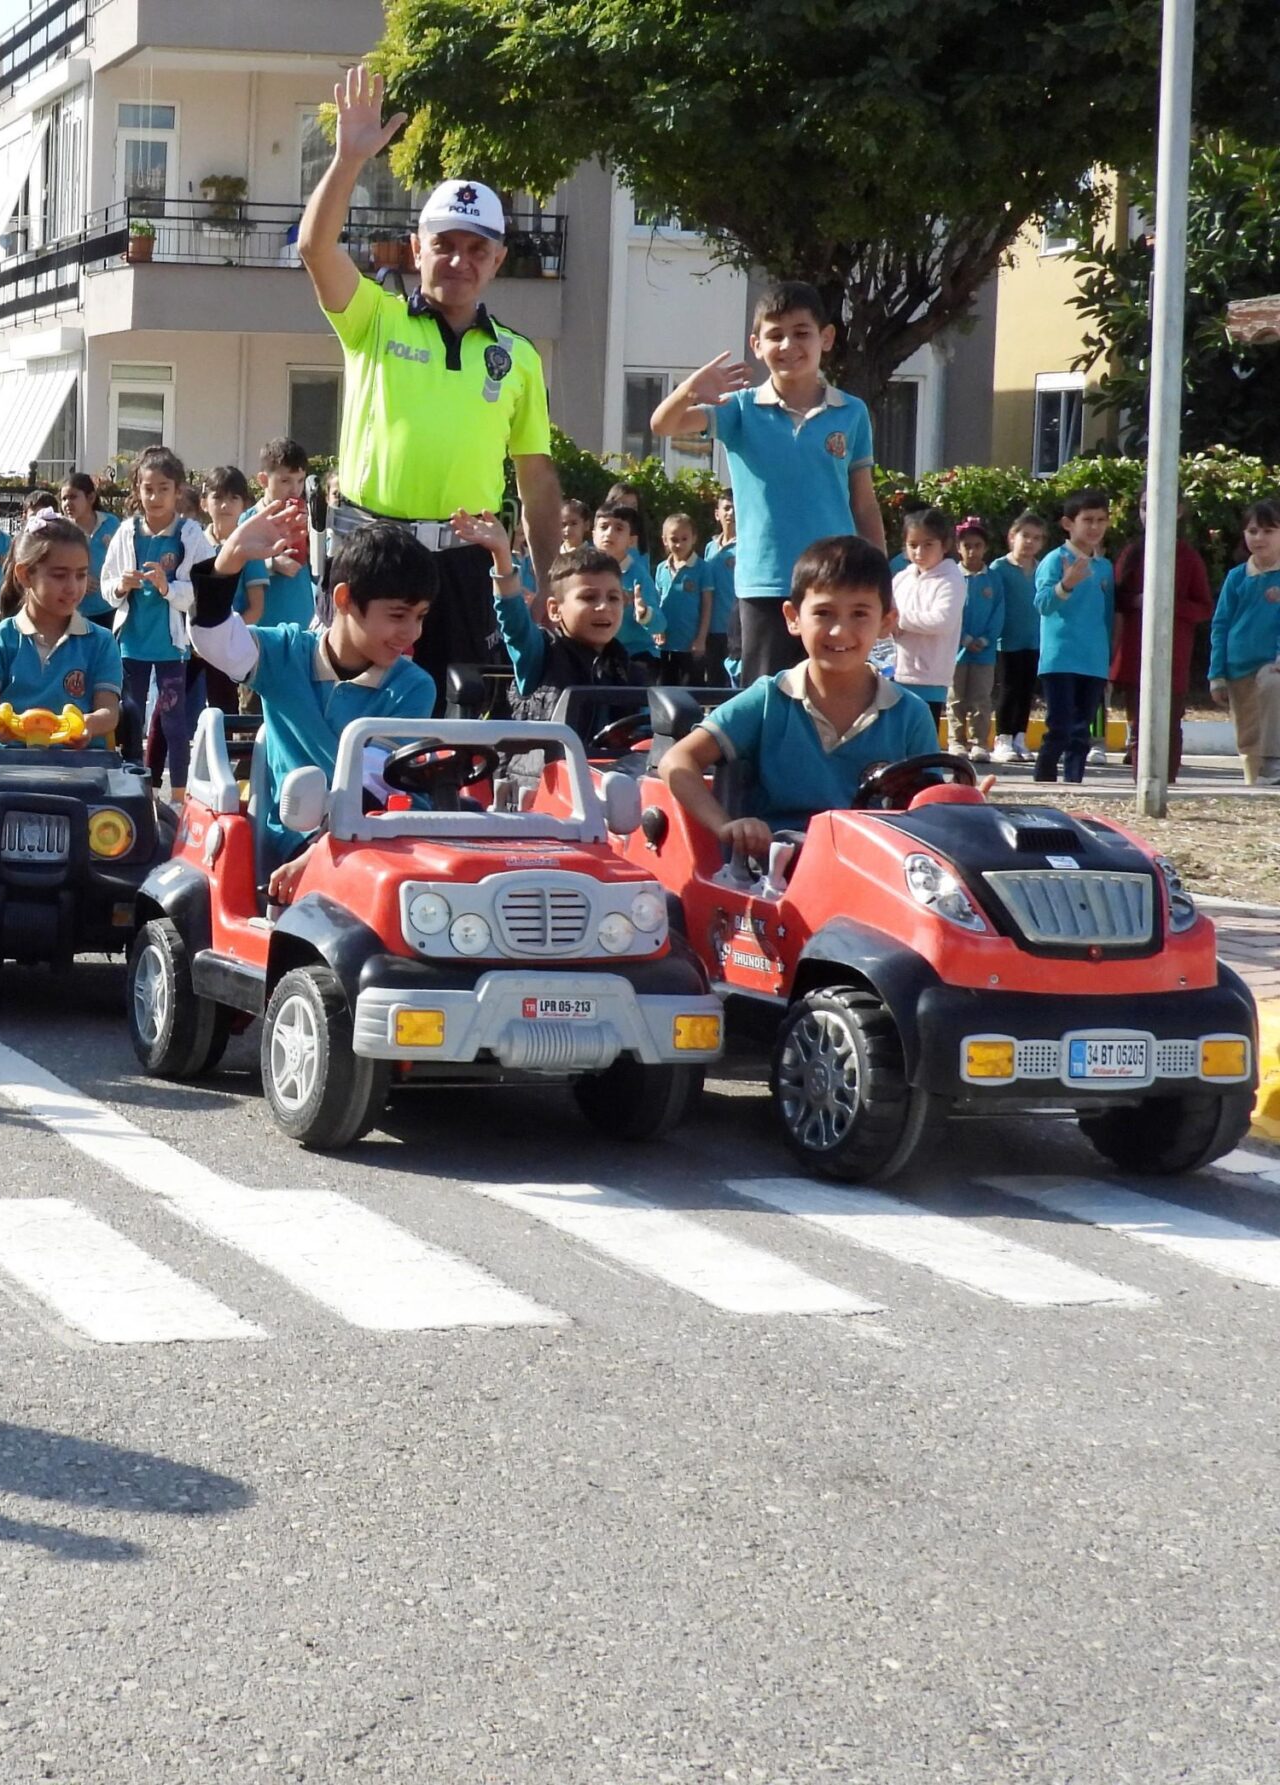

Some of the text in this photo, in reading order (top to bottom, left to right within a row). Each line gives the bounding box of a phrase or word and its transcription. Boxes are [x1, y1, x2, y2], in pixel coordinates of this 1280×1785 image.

[732, 951, 772, 972] THUNDER
[540, 1000, 591, 1013] LPR 05-213
[1087, 1044, 1145, 1065] 34 BT 05205
